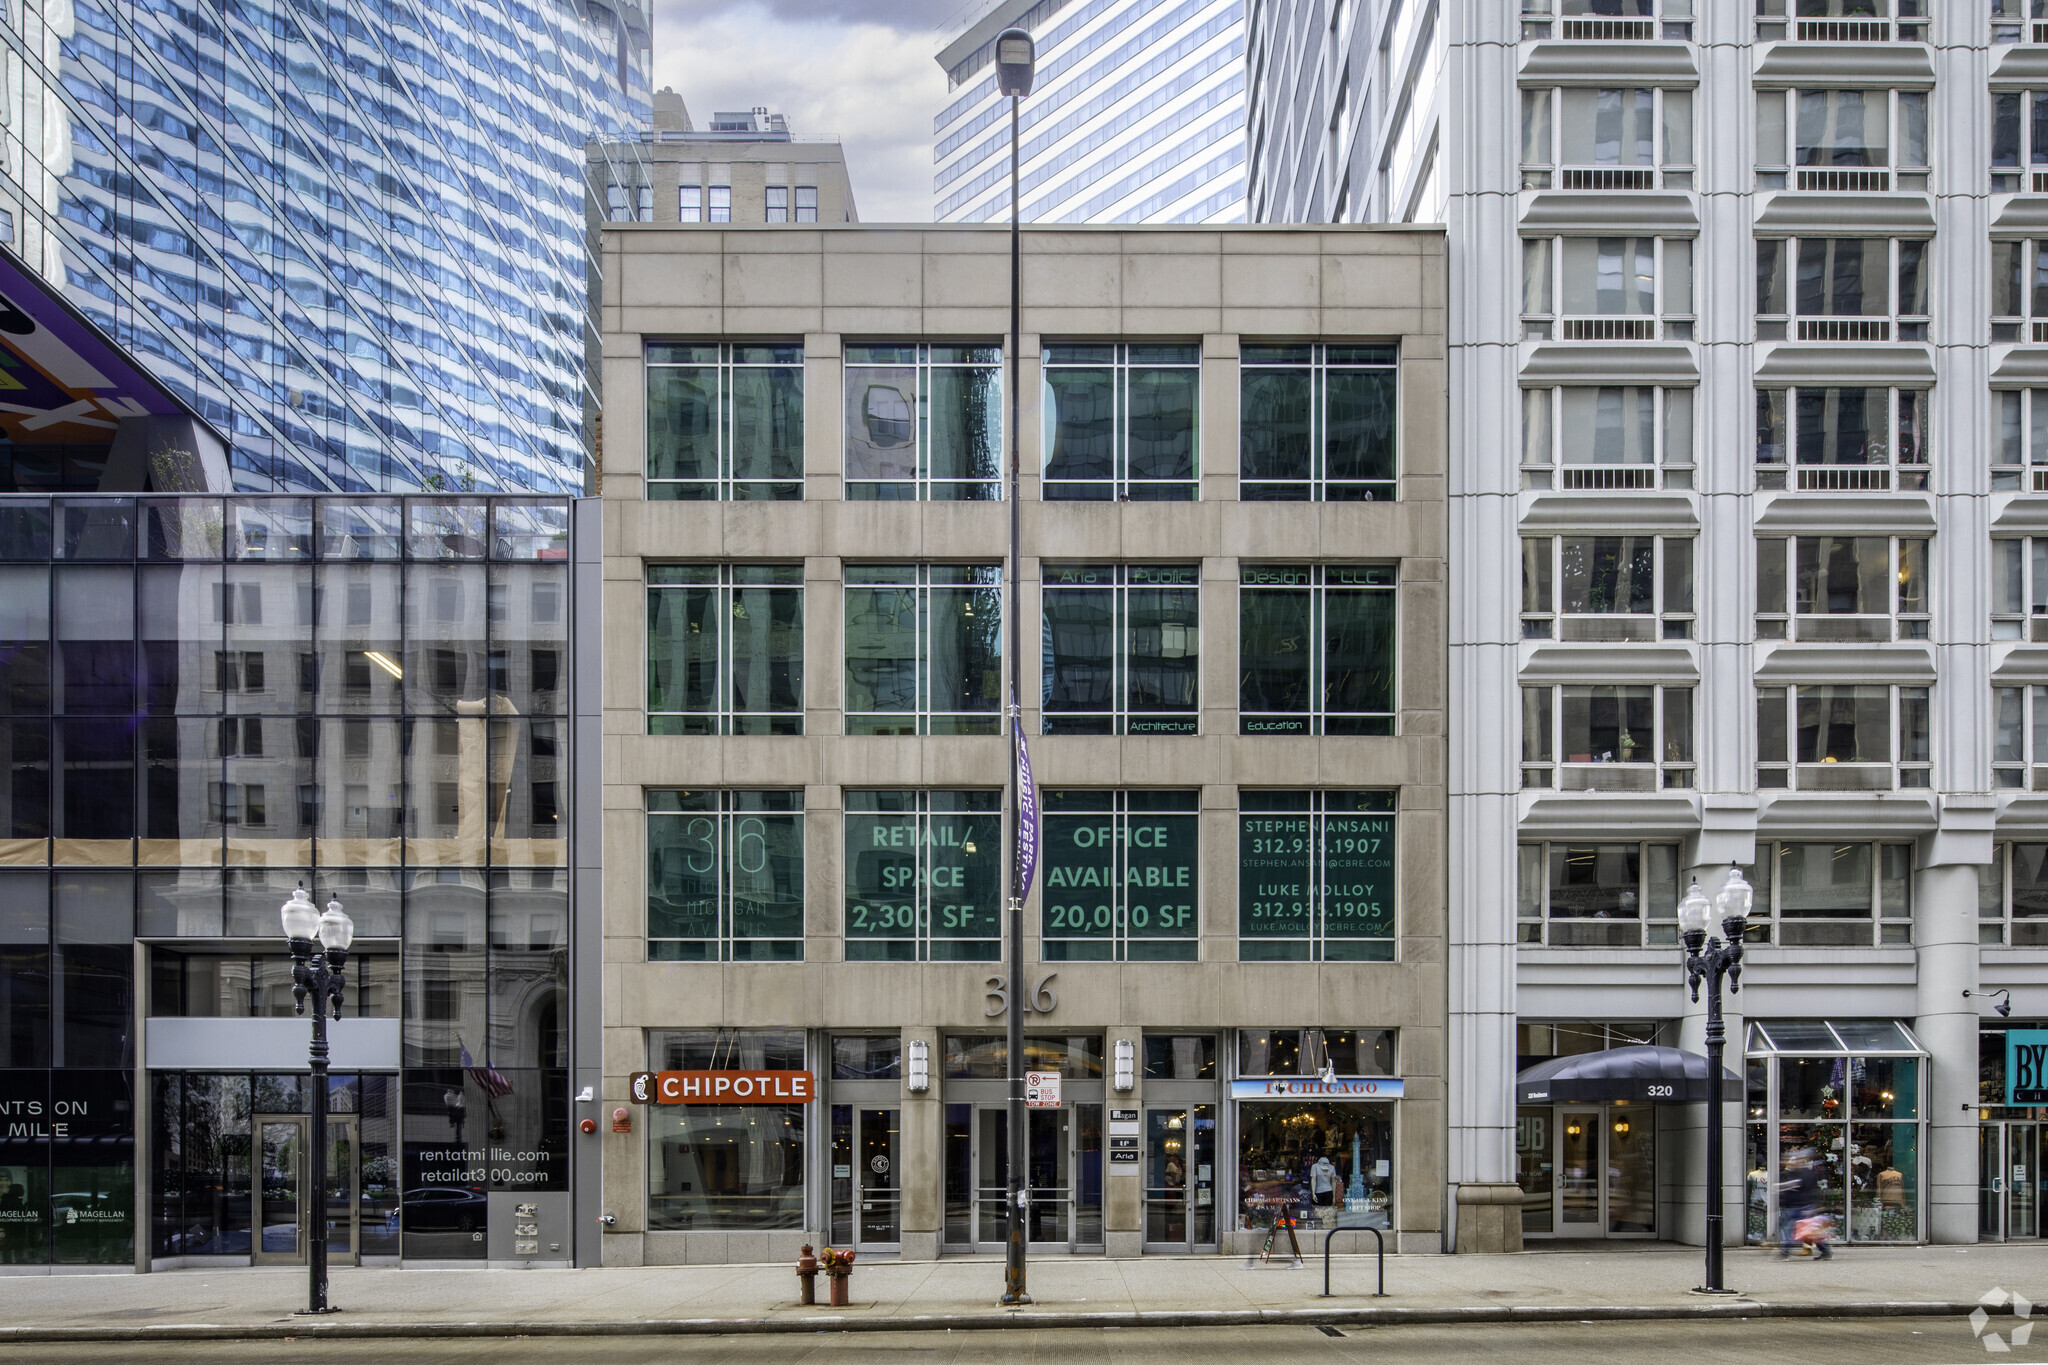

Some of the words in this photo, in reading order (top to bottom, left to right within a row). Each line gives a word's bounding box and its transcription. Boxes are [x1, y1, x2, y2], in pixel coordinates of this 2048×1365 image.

[1060, 569, 1097, 583] Aria
[1134, 569, 1192, 584] Public
[1243, 570, 1308, 585] Design
[1341, 570, 1379, 584] LLC
[1129, 721, 1196, 731] Architecture
[1247, 721, 1303, 731] Education
[1245, 820, 1319, 833] STEPHEN
[1325, 820, 1390, 833] ANSANI
[1073, 826, 1168, 848] OFFICE
[687, 817, 766, 873] 316
[1252, 838, 1381, 854] 312.935.1907
[882, 866, 965, 888] SPACE
[1046, 866, 1190, 888] AVAILABLE
[1259, 884, 1300, 896] LUKE
[1306, 884, 1375, 896] MOLLOY
[1252, 902, 1382, 917] 312.935.1905
[852, 905, 932, 932] 2,300
[943, 905, 975, 928] SF
[1050, 904, 1149, 932] 20,000
[1159, 904, 1191, 928] SF
[662, 1076, 807, 1098] CHIPOTLE
[1287, 1082, 1378, 1094] CHICAGO
[1647, 1085, 1673, 1097] 320
[54, 1101, 88, 1116] ON
[8, 1122, 69, 1137] MILE
[0, 1210, 39, 1218] AGELLAN
[79, 1210, 125, 1218] MAGELLAN
